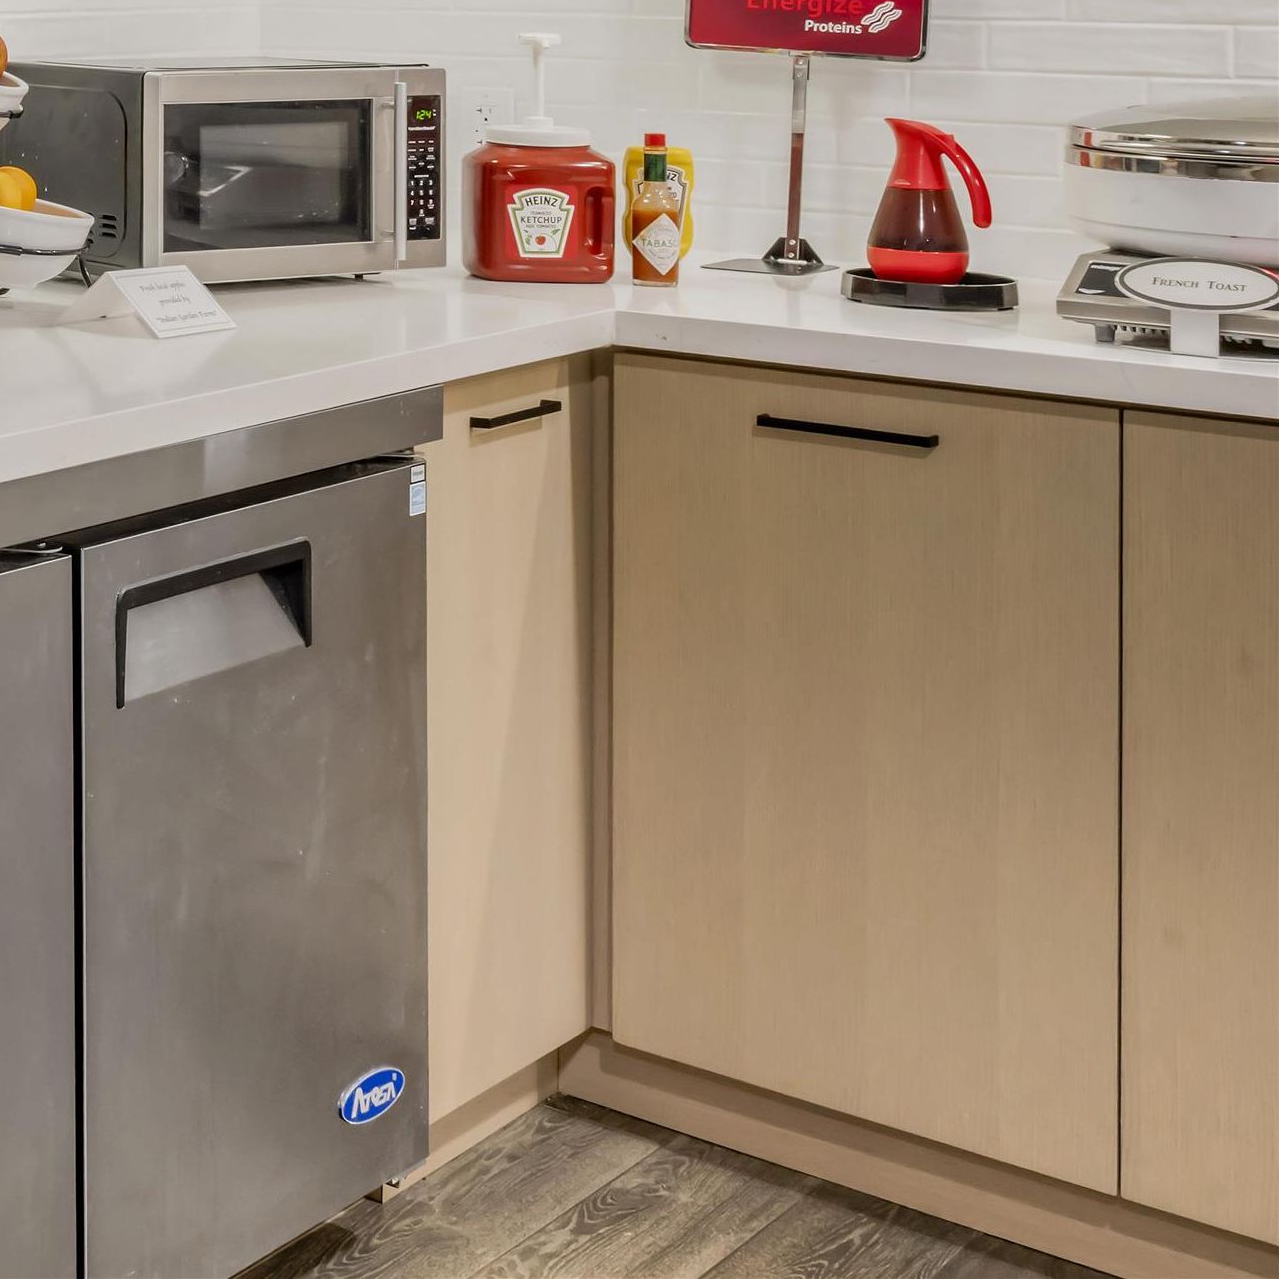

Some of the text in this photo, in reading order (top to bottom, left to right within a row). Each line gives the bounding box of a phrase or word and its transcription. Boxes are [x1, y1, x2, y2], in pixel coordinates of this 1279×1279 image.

[804, 19, 862, 35] Proteins
[525, 196, 559, 207] HEINZ
[520, 216, 563, 224] KETCHUP
